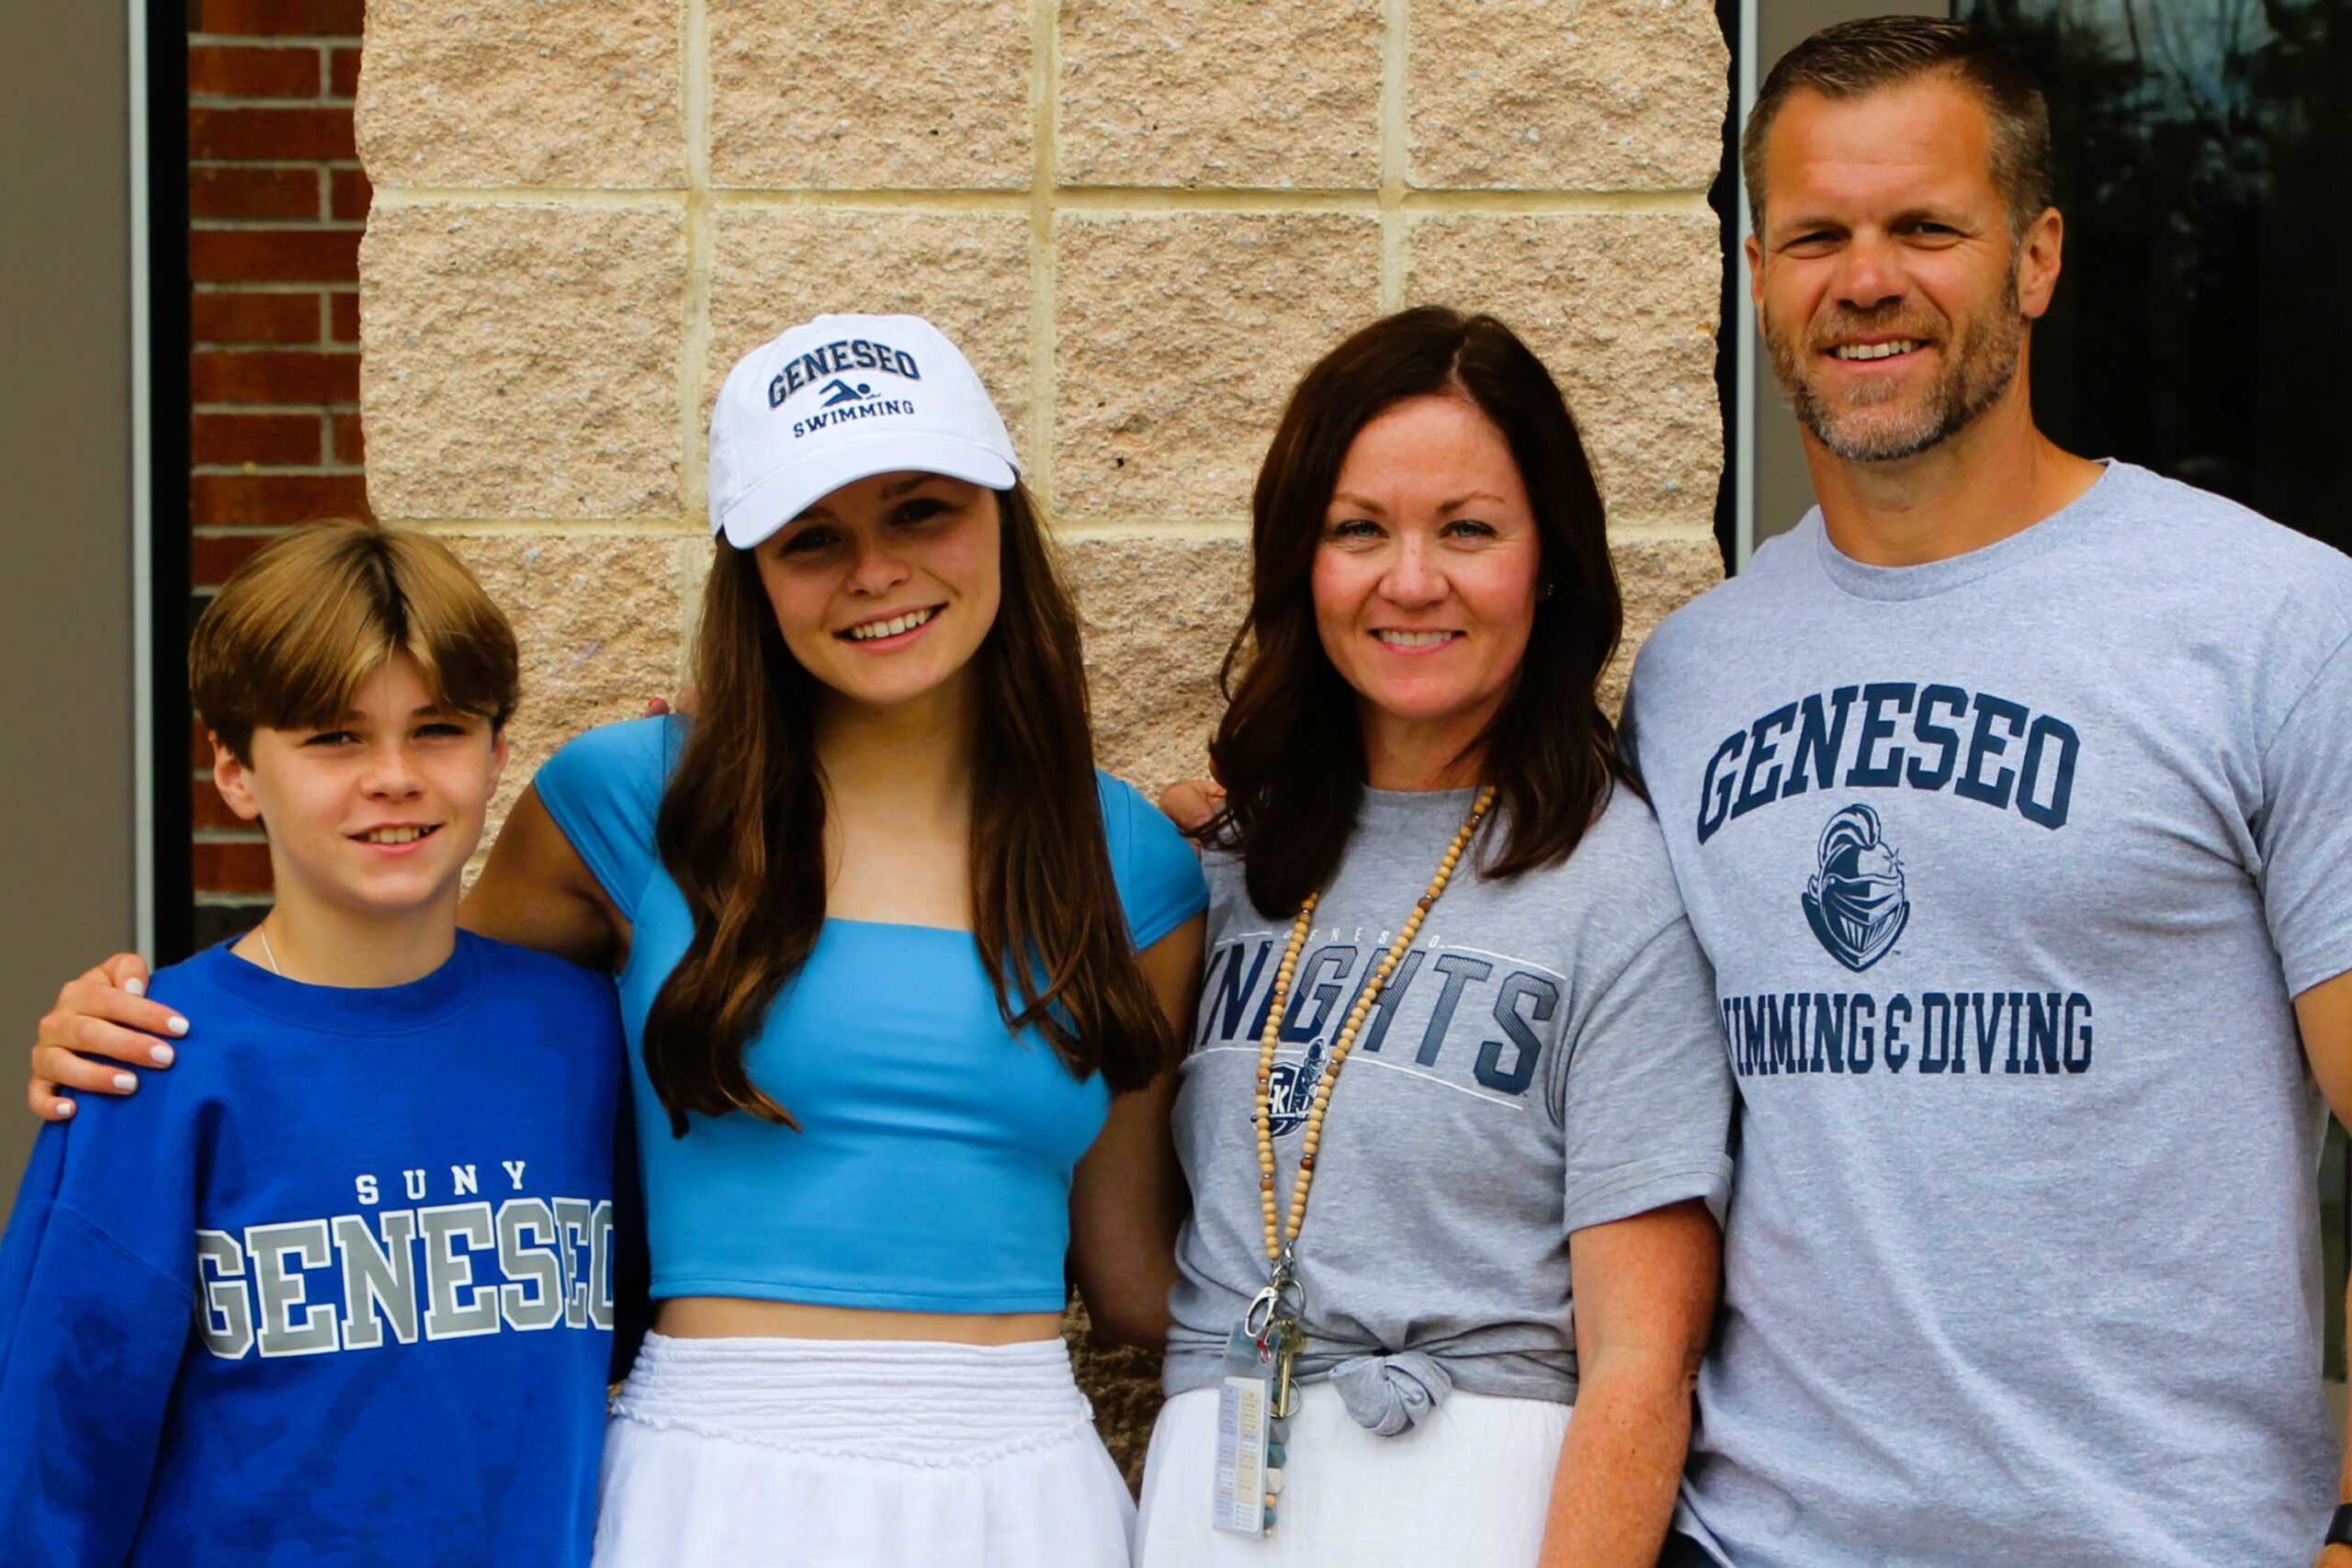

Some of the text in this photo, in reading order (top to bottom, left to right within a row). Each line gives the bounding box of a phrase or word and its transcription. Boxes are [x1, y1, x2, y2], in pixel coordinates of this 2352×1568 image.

[768, 339, 922, 412] GENESEO
[793, 400, 915, 438] SWIMMING
[1696, 682, 2080, 846] GENESEO
[1283, 927, 1441, 948] GENESO
[1199, 940, 1560, 1096] NIGHTS
[1883, 993, 1913, 1074] &
[1918, 992, 2093, 1075] DIVING
[355, 1160, 526, 1205] SUNY
